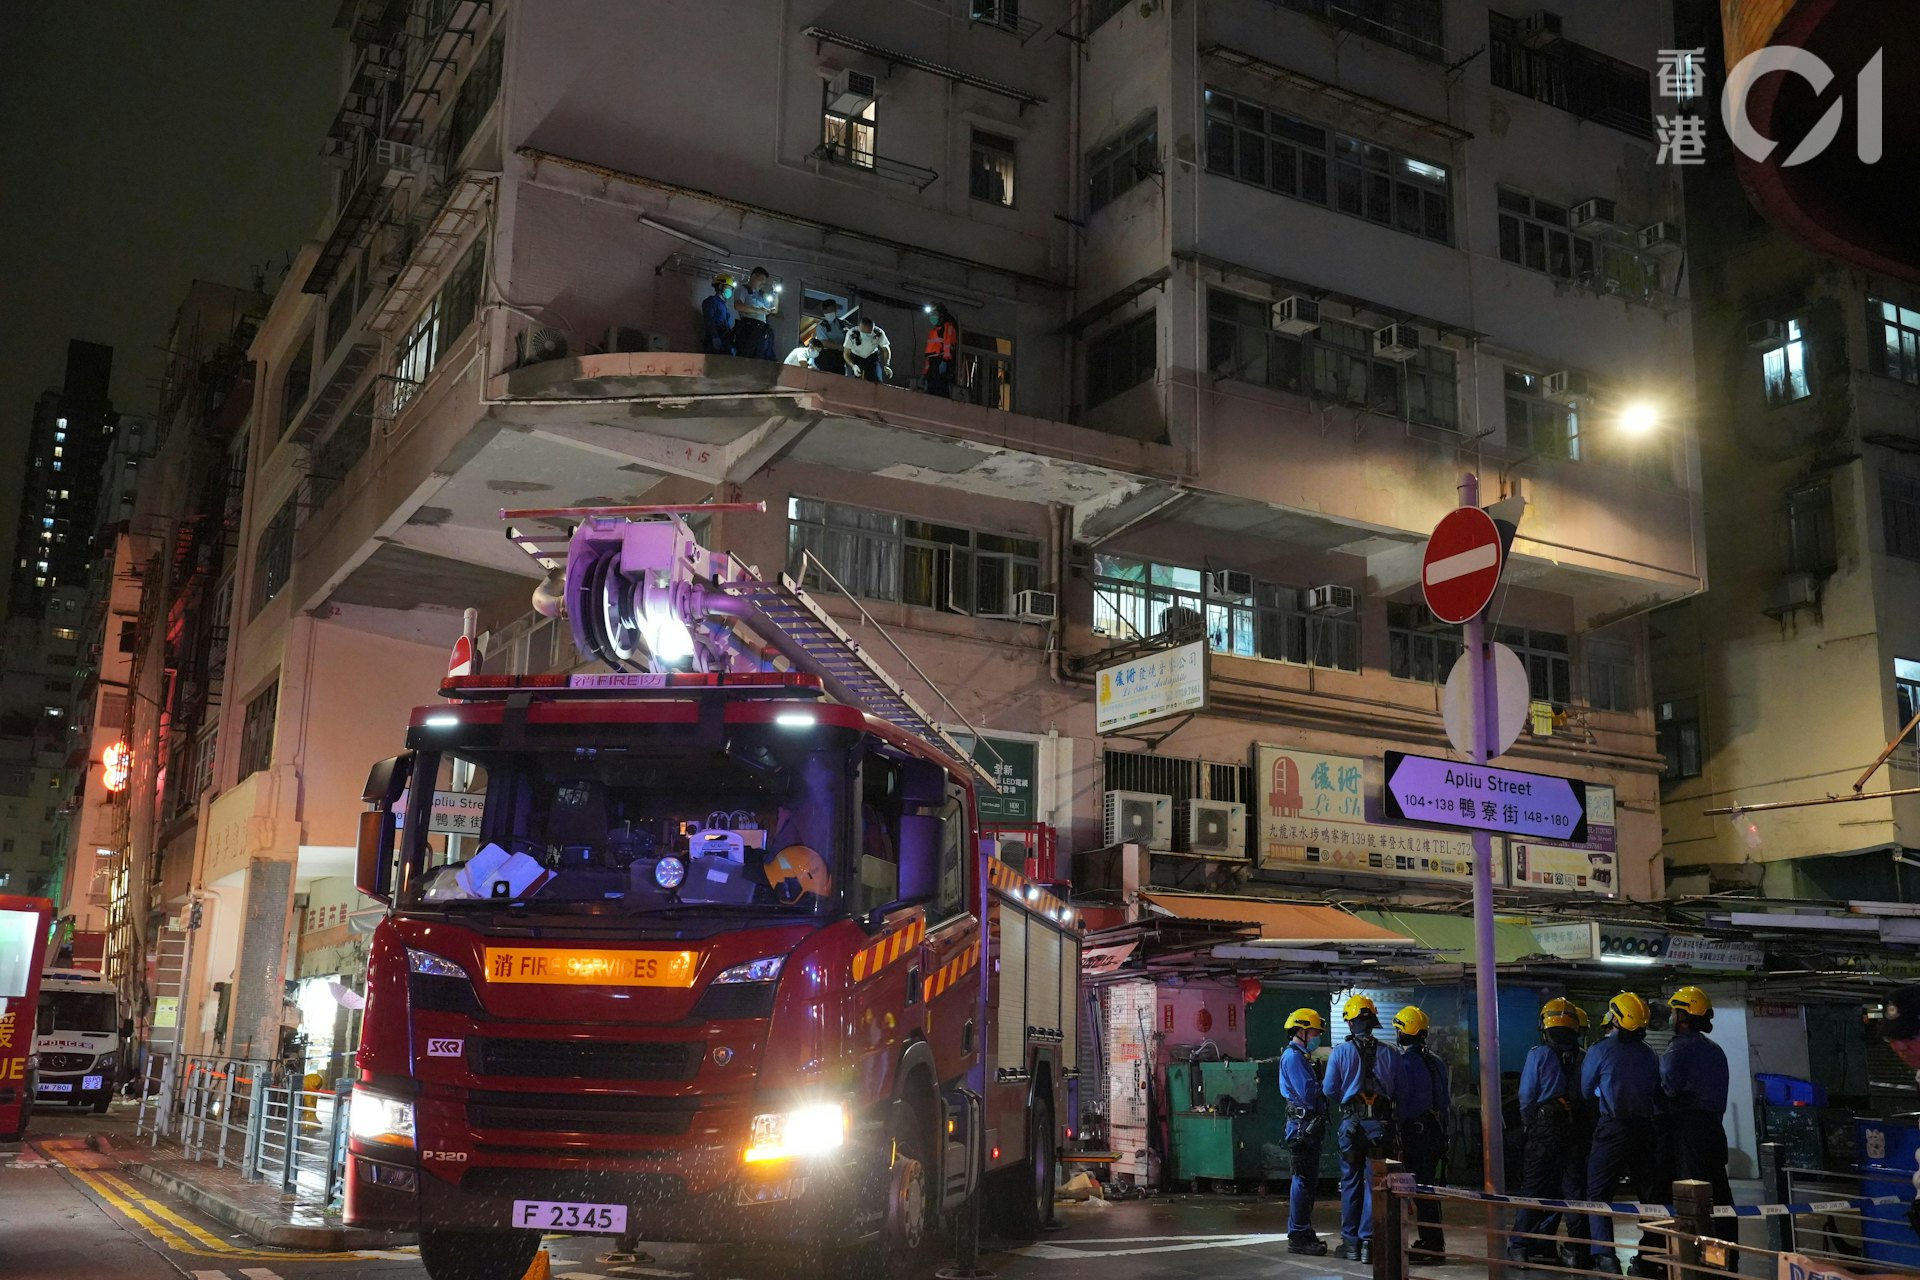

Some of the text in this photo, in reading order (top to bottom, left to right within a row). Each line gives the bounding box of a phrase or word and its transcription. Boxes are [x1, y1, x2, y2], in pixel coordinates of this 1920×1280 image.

[597, 675, 639, 687] FIRE
[1444, 769, 1532, 796] Apliu Street
[432, 796, 484, 810] pliu Stre
[1338, 797, 1361, 816] Sh
[1459, 797, 1519, 825] 鴨寮街
[494, 954, 513, 977] 消
[520, 956, 561, 977] FIRE
[566, 957, 658, 979] SERVICES
[422, 1150, 468, 1162] P 320
[523, 1204, 613, 1228] F 2345
